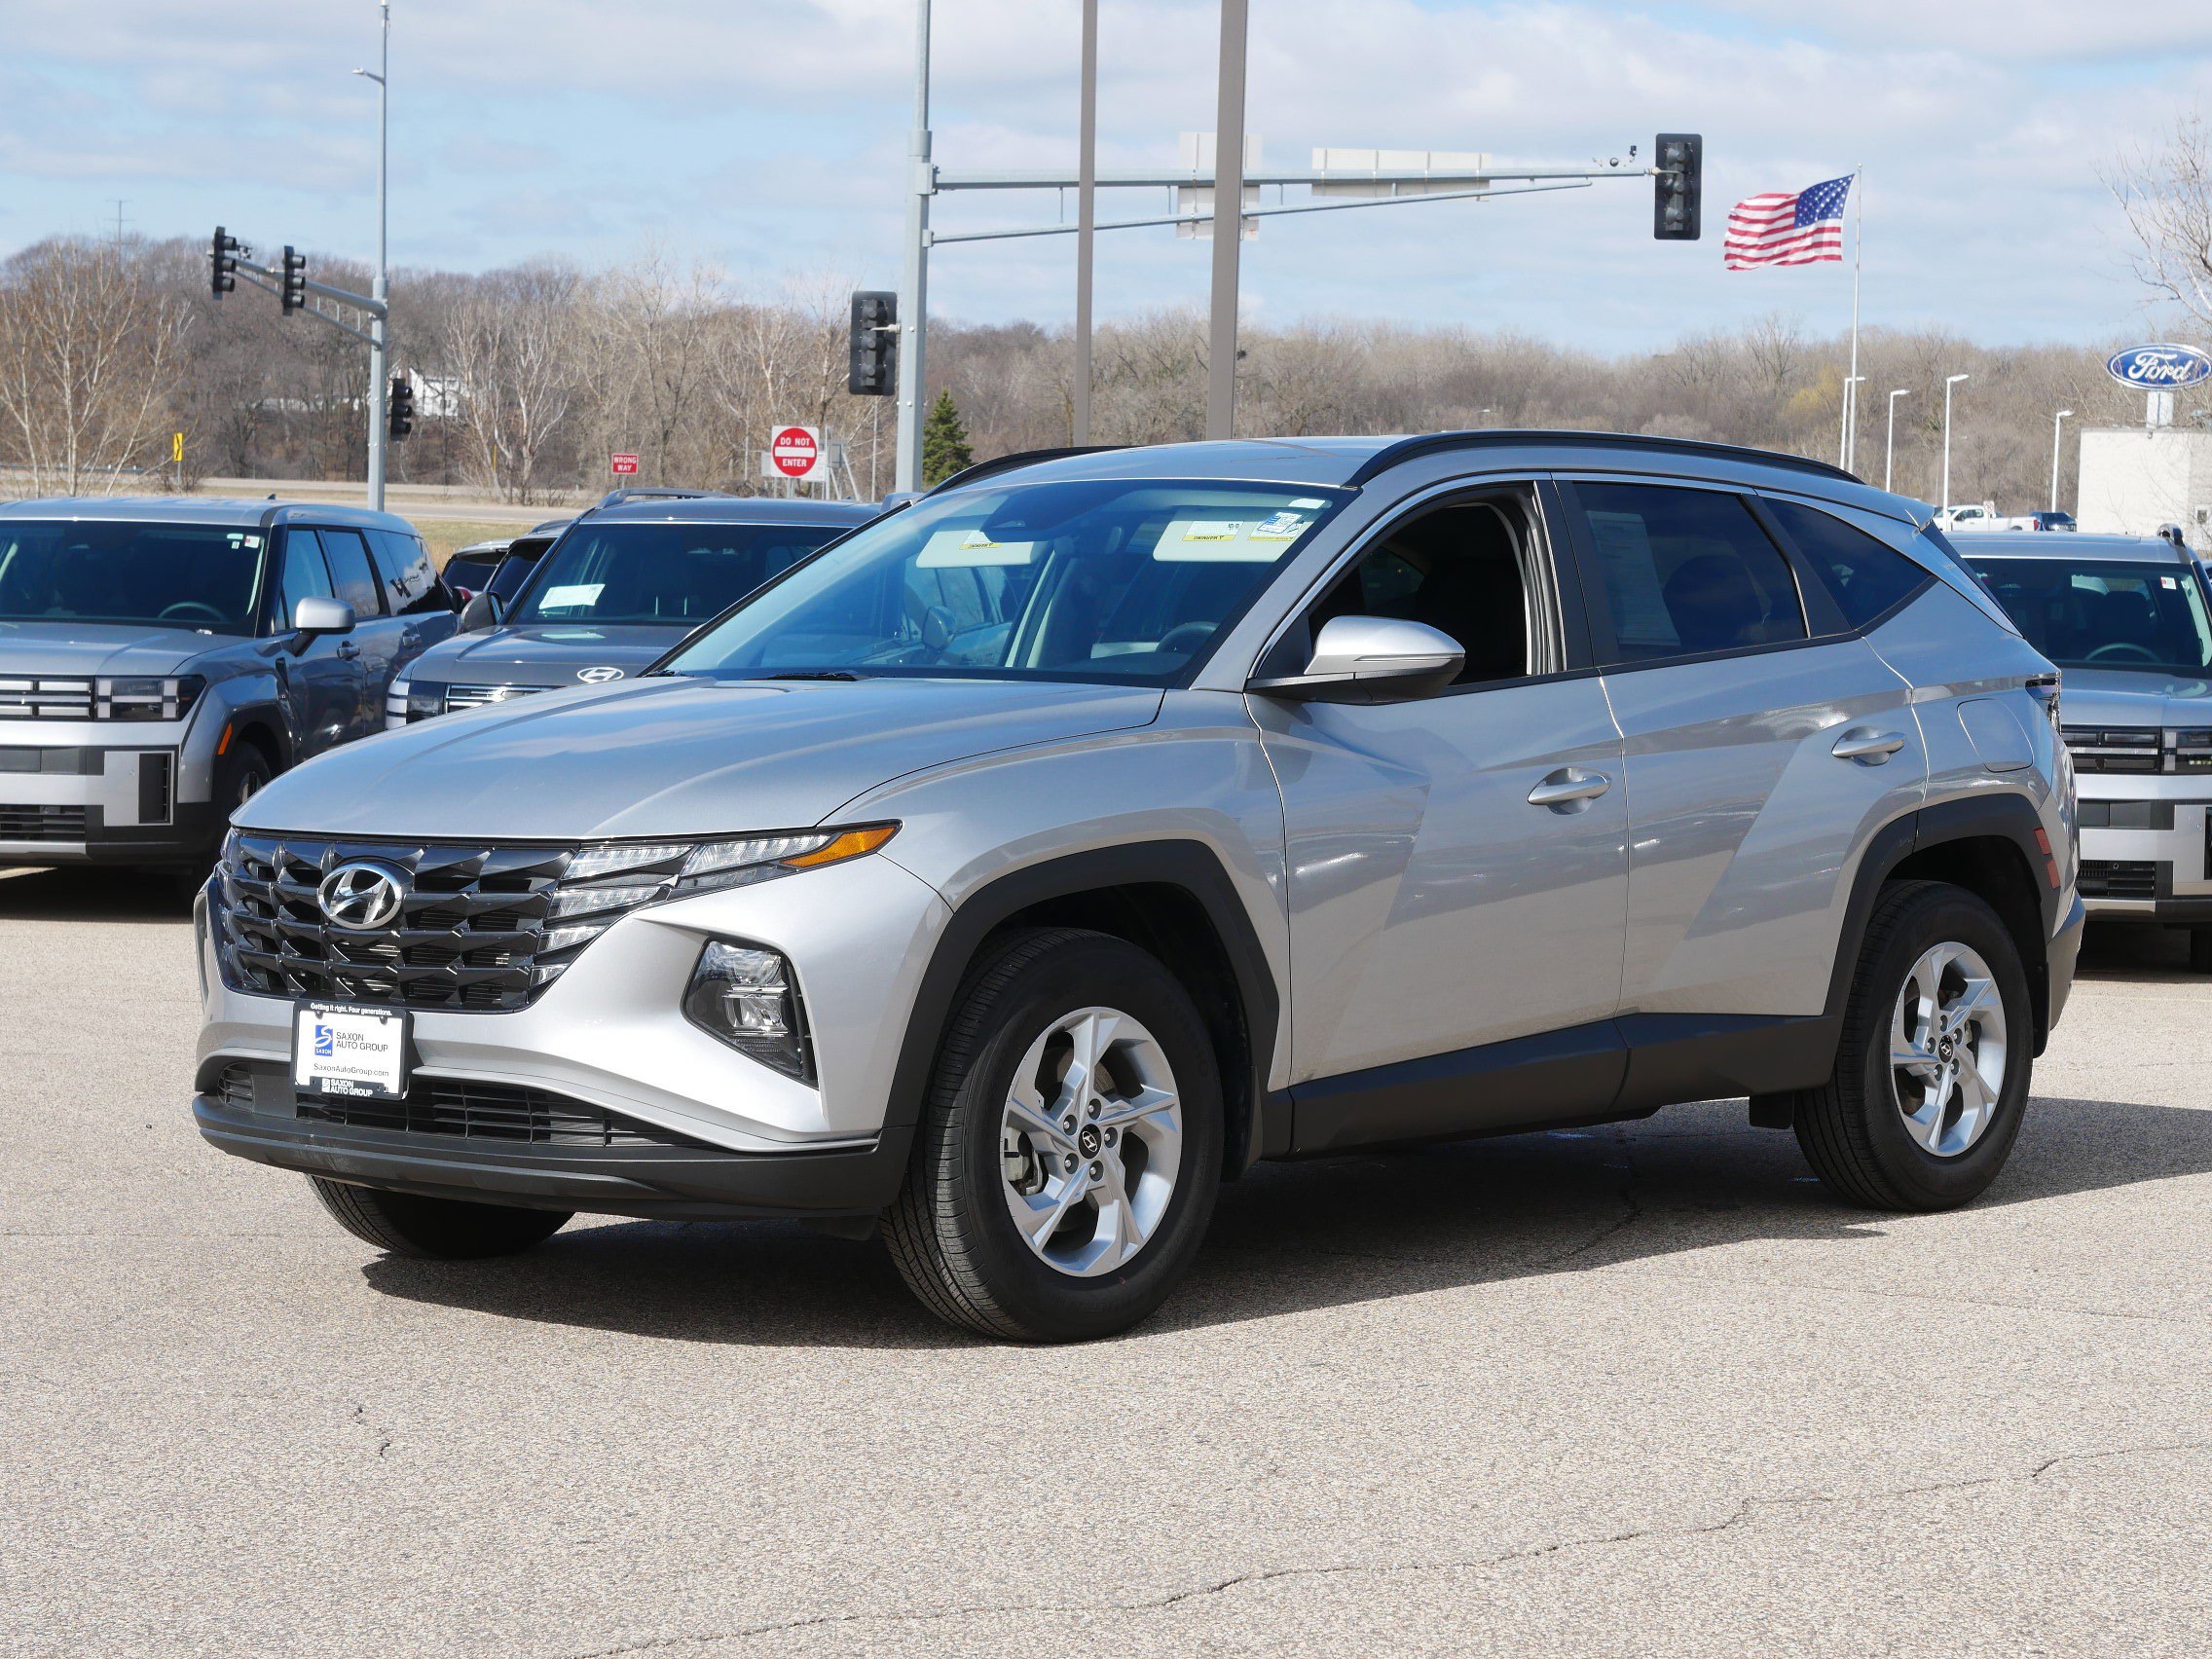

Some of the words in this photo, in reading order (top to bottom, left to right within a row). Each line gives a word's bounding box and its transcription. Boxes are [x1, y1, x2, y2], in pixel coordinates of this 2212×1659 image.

[2127, 351, 2194, 381] Ford
[780, 436, 792, 446] DO
[794, 437, 811, 446] NOT
[613, 456, 637, 464] WRONG
[782, 458, 807, 467] ENTER
[617, 463, 633, 472] WAY
[311, 1002, 329, 1012] Getting
[336, 1032, 364, 1041] SAXON
[336, 1041, 357, 1049] AUTO
[360, 1043, 388, 1052] GROUP
[313, 1063, 389, 1077] SaxonAutoGroup.com
[331, 1079, 353, 1088] SAXON
[349, 1088, 373, 1097] GROUP
